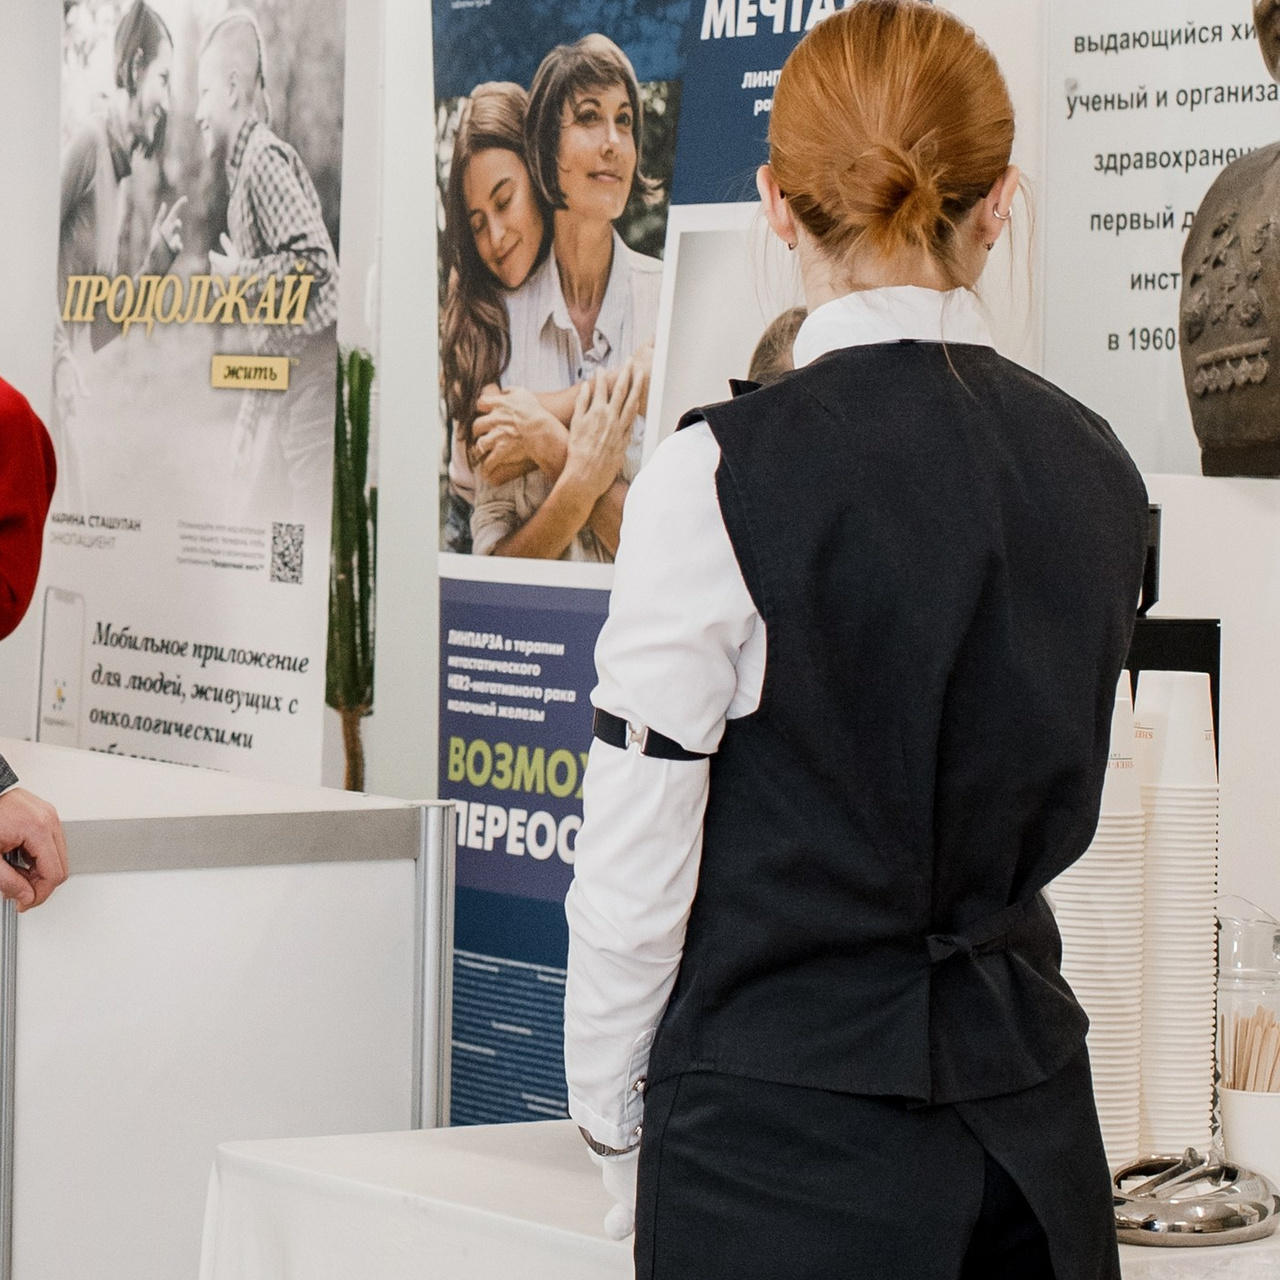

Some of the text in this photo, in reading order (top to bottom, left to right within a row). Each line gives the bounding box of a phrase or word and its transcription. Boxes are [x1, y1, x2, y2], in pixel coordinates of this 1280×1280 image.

[1074, 20, 1223, 55] выдающийся
[1066, 82, 1279, 120] ученый и организа
[1093, 146, 1258, 176] здравохране
[1090, 205, 1175, 236] первый
[1130, 272, 1181, 290] инст
[61, 260, 315, 339] ПРОДОЛЖАЙ
[1108, 327, 1176, 351] в 1960
[223, 365, 277, 381] жить
[92, 621, 310, 674] Мобильное приложение
[91, 663, 299, 715] для людей, живущих с
[89, 708, 254, 749] онкологическими
[447, 735, 589, 800] ВОЗМО
